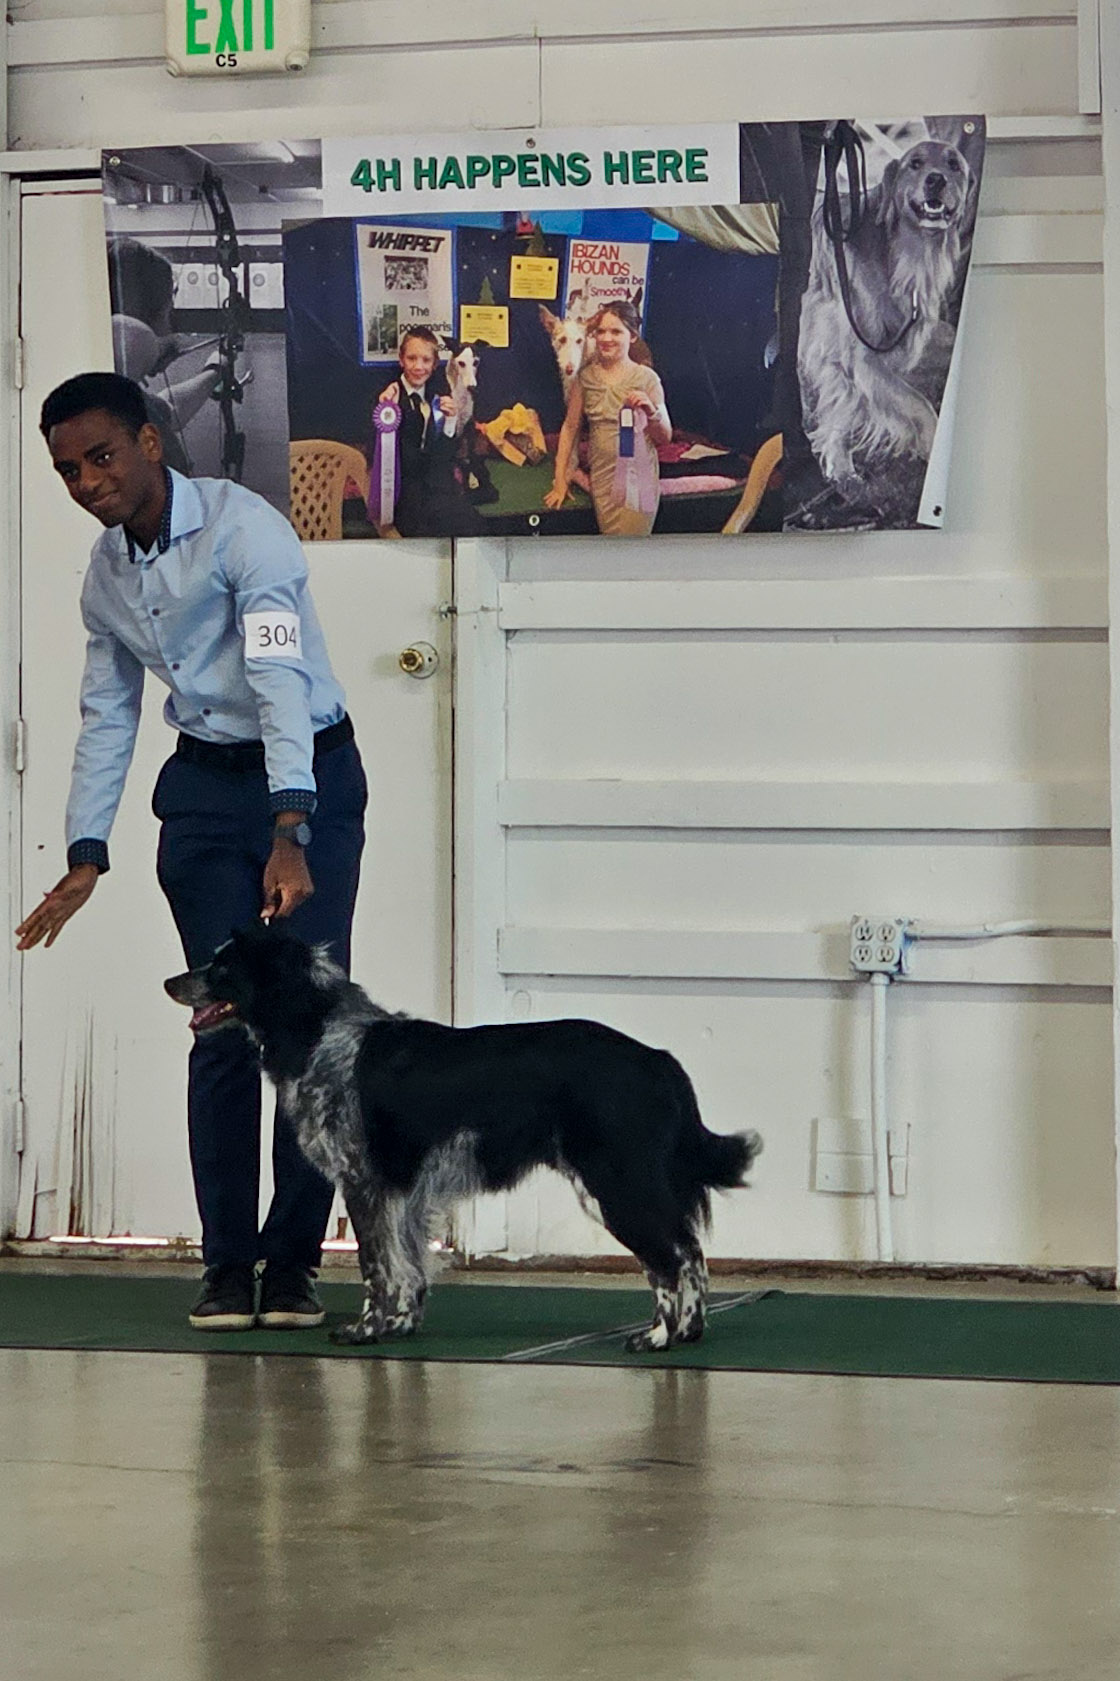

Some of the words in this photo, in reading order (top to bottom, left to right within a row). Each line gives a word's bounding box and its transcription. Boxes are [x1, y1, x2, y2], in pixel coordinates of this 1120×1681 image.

[215, 53, 237, 67] C5
[350, 157, 401, 192] 4H
[414, 152, 592, 190] HAPPENS
[603, 148, 708, 185] HERE
[368, 231, 445, 253] WHIPPET
[572, 243, 620, 260] IBIZAN
[570, 259, 631, 276] HOUNDS
[612, 276, 630, 285] can
[632, 275, 644, 286] be
[409, 305, 429, 317] The
[257, 624, 297, 649] 304
